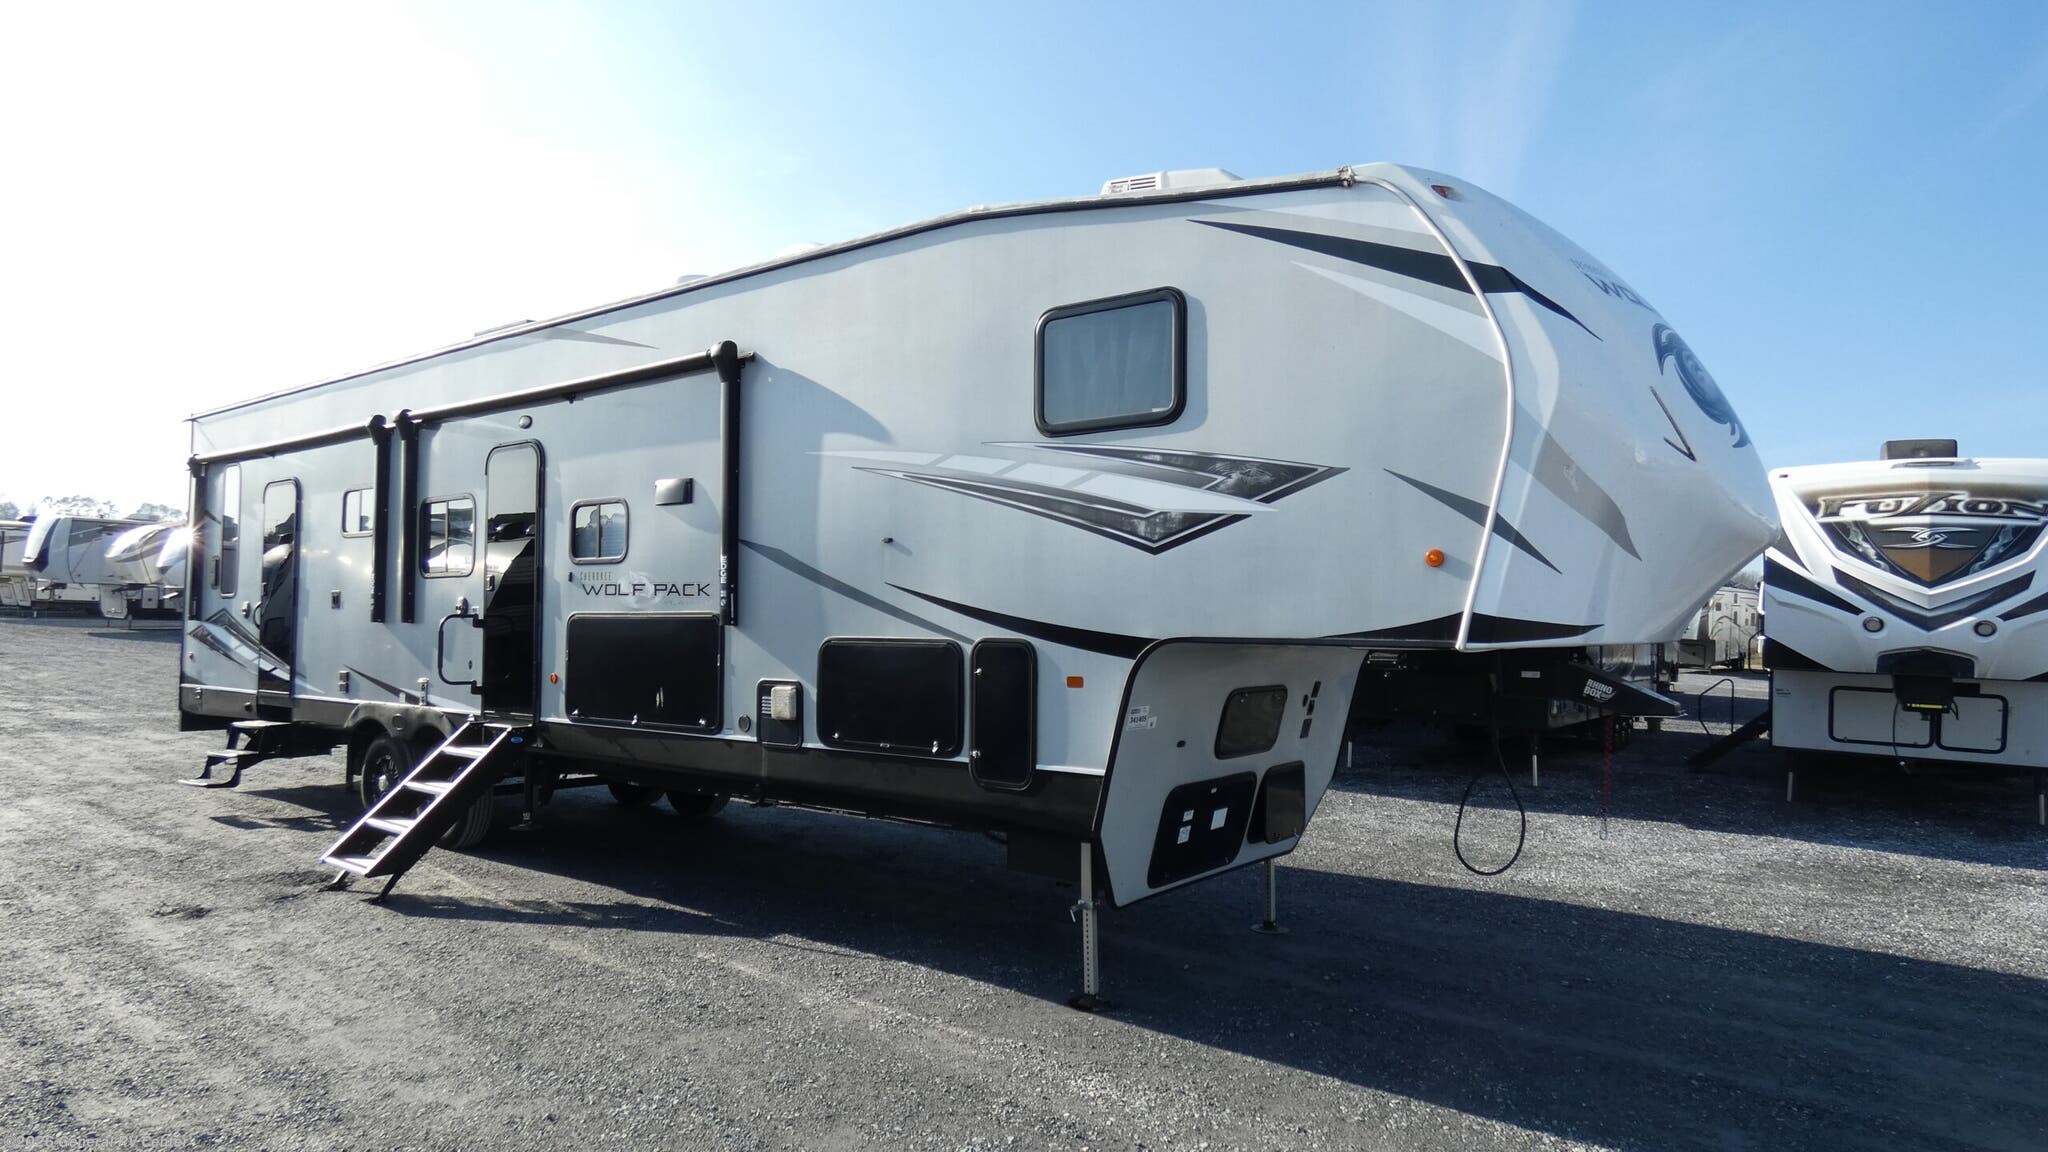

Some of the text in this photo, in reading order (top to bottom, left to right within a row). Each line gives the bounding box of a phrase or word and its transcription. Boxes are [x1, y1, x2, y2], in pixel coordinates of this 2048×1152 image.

[582, 583, 711, 597] WOLF PACK
[1583, 685, 1602, 699] BOX
[1586, 679, 1613, 694] RHINO
